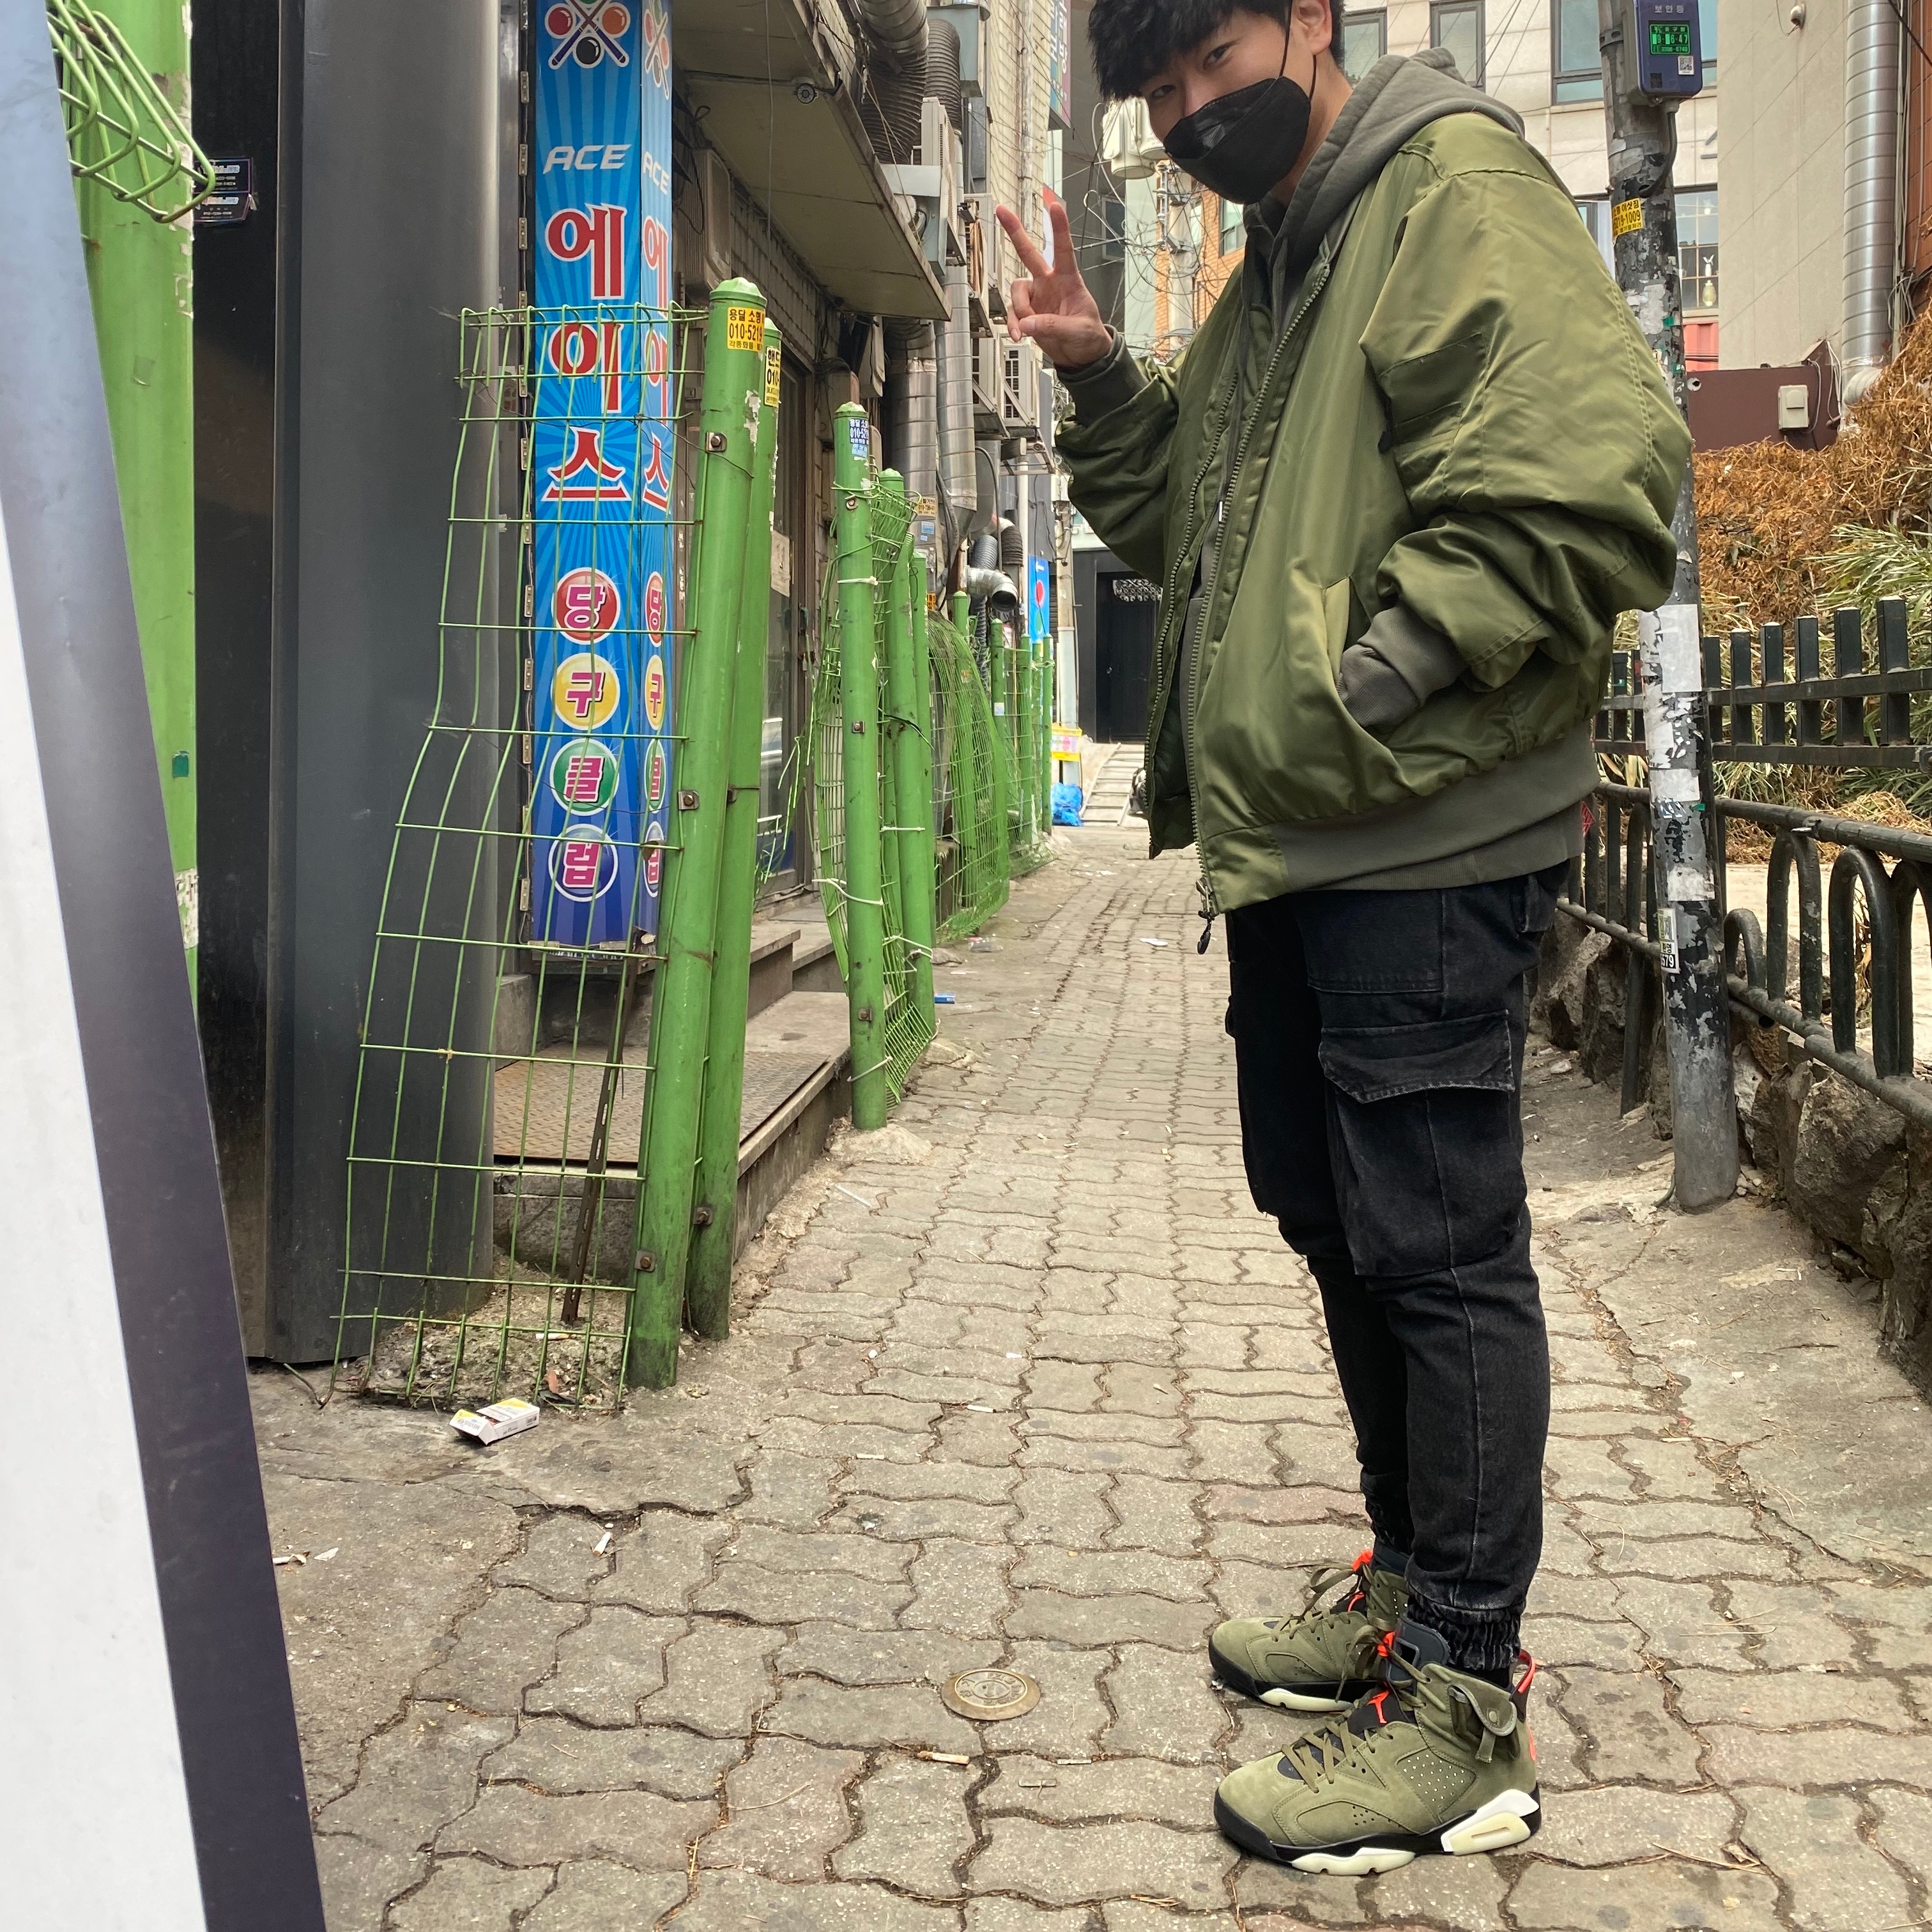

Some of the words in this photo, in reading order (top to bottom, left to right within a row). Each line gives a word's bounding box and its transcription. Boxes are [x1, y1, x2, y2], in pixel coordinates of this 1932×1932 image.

[542, 144, 632, 174] ACE
[643, 151, 670, 195] ACE
[1621, 200, 1639, 211] 이삿짐
[748, 310, 761, 324] 소형
